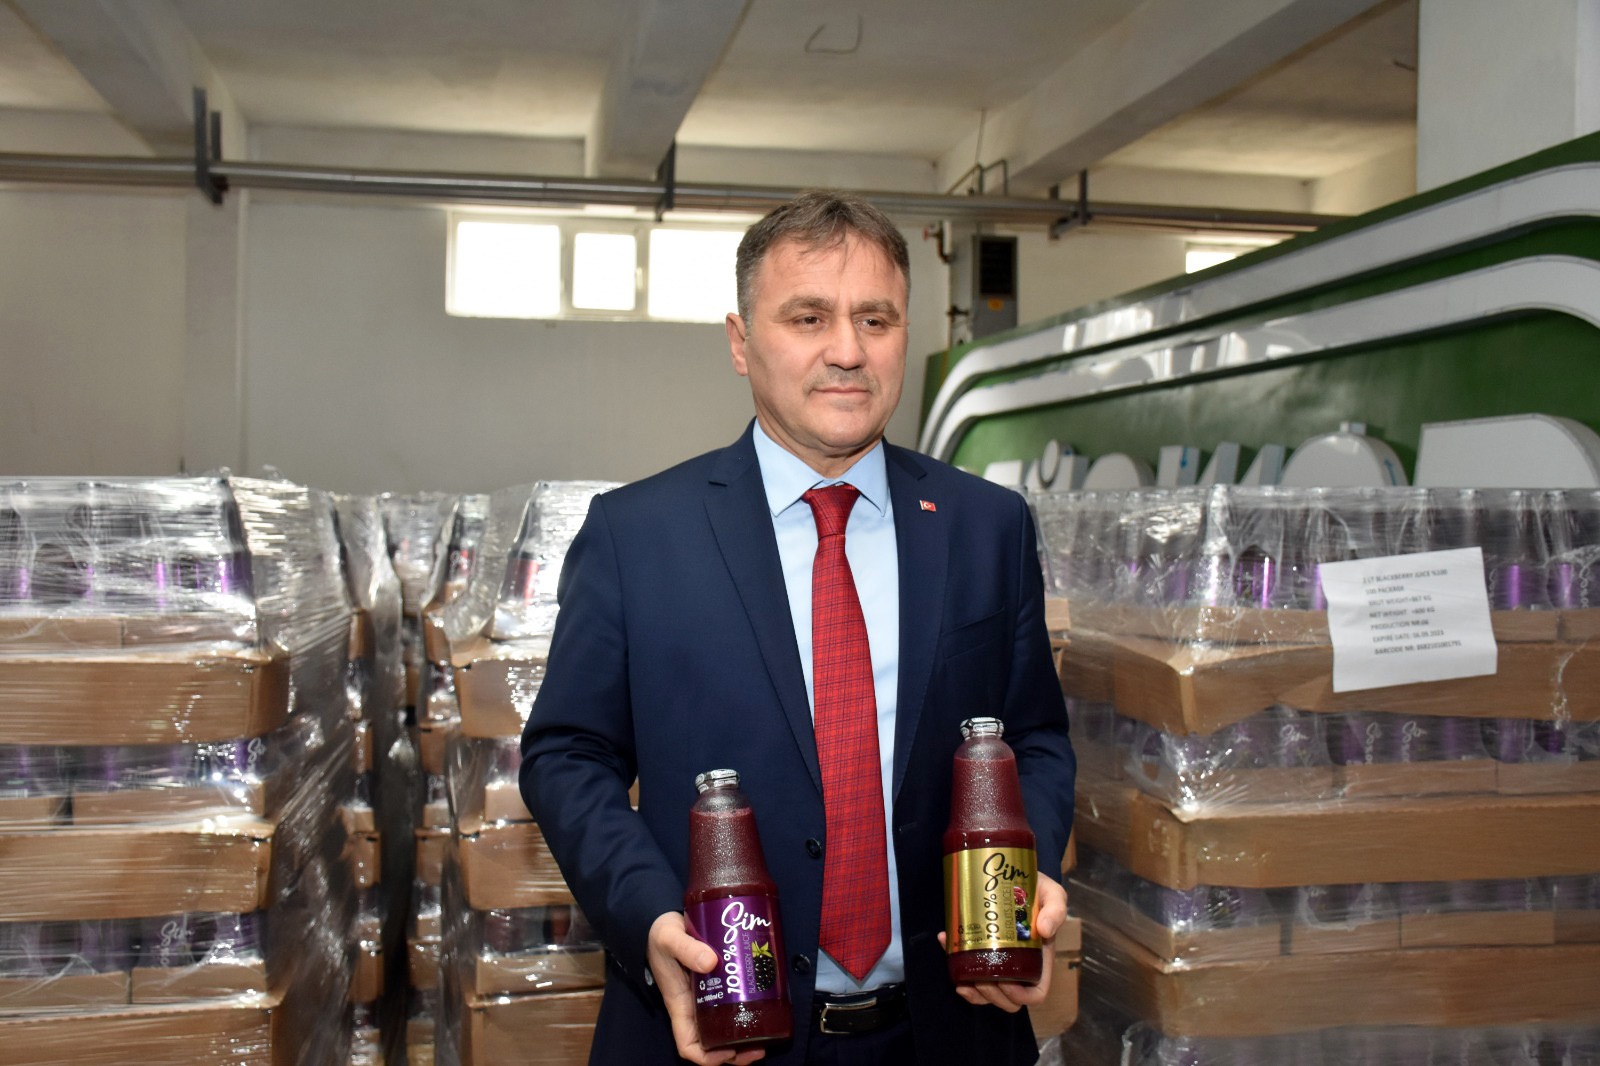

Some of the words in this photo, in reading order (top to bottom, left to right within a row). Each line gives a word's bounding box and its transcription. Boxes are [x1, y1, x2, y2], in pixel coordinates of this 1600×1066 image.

[1375, 573, 1414, 582] BLACKBERRY
[1383, 608, 1407, 617] WEIGHT
[1370, 620, 1410, 630] PRODUCTION
[1373, 634, 1393, 643] EXPIRE
[1375, 645, 1403, 655] BARCODE
[982, 852, 1030, 892] Sim
[721, 901, 772, 944] Sim
[984, 894, 1001, 940] 100%
[742, 933, 752, 951] JUICE
[723, 944, 743, 994] 100%
[744, 953, 756, 994] BLACKBERRY
